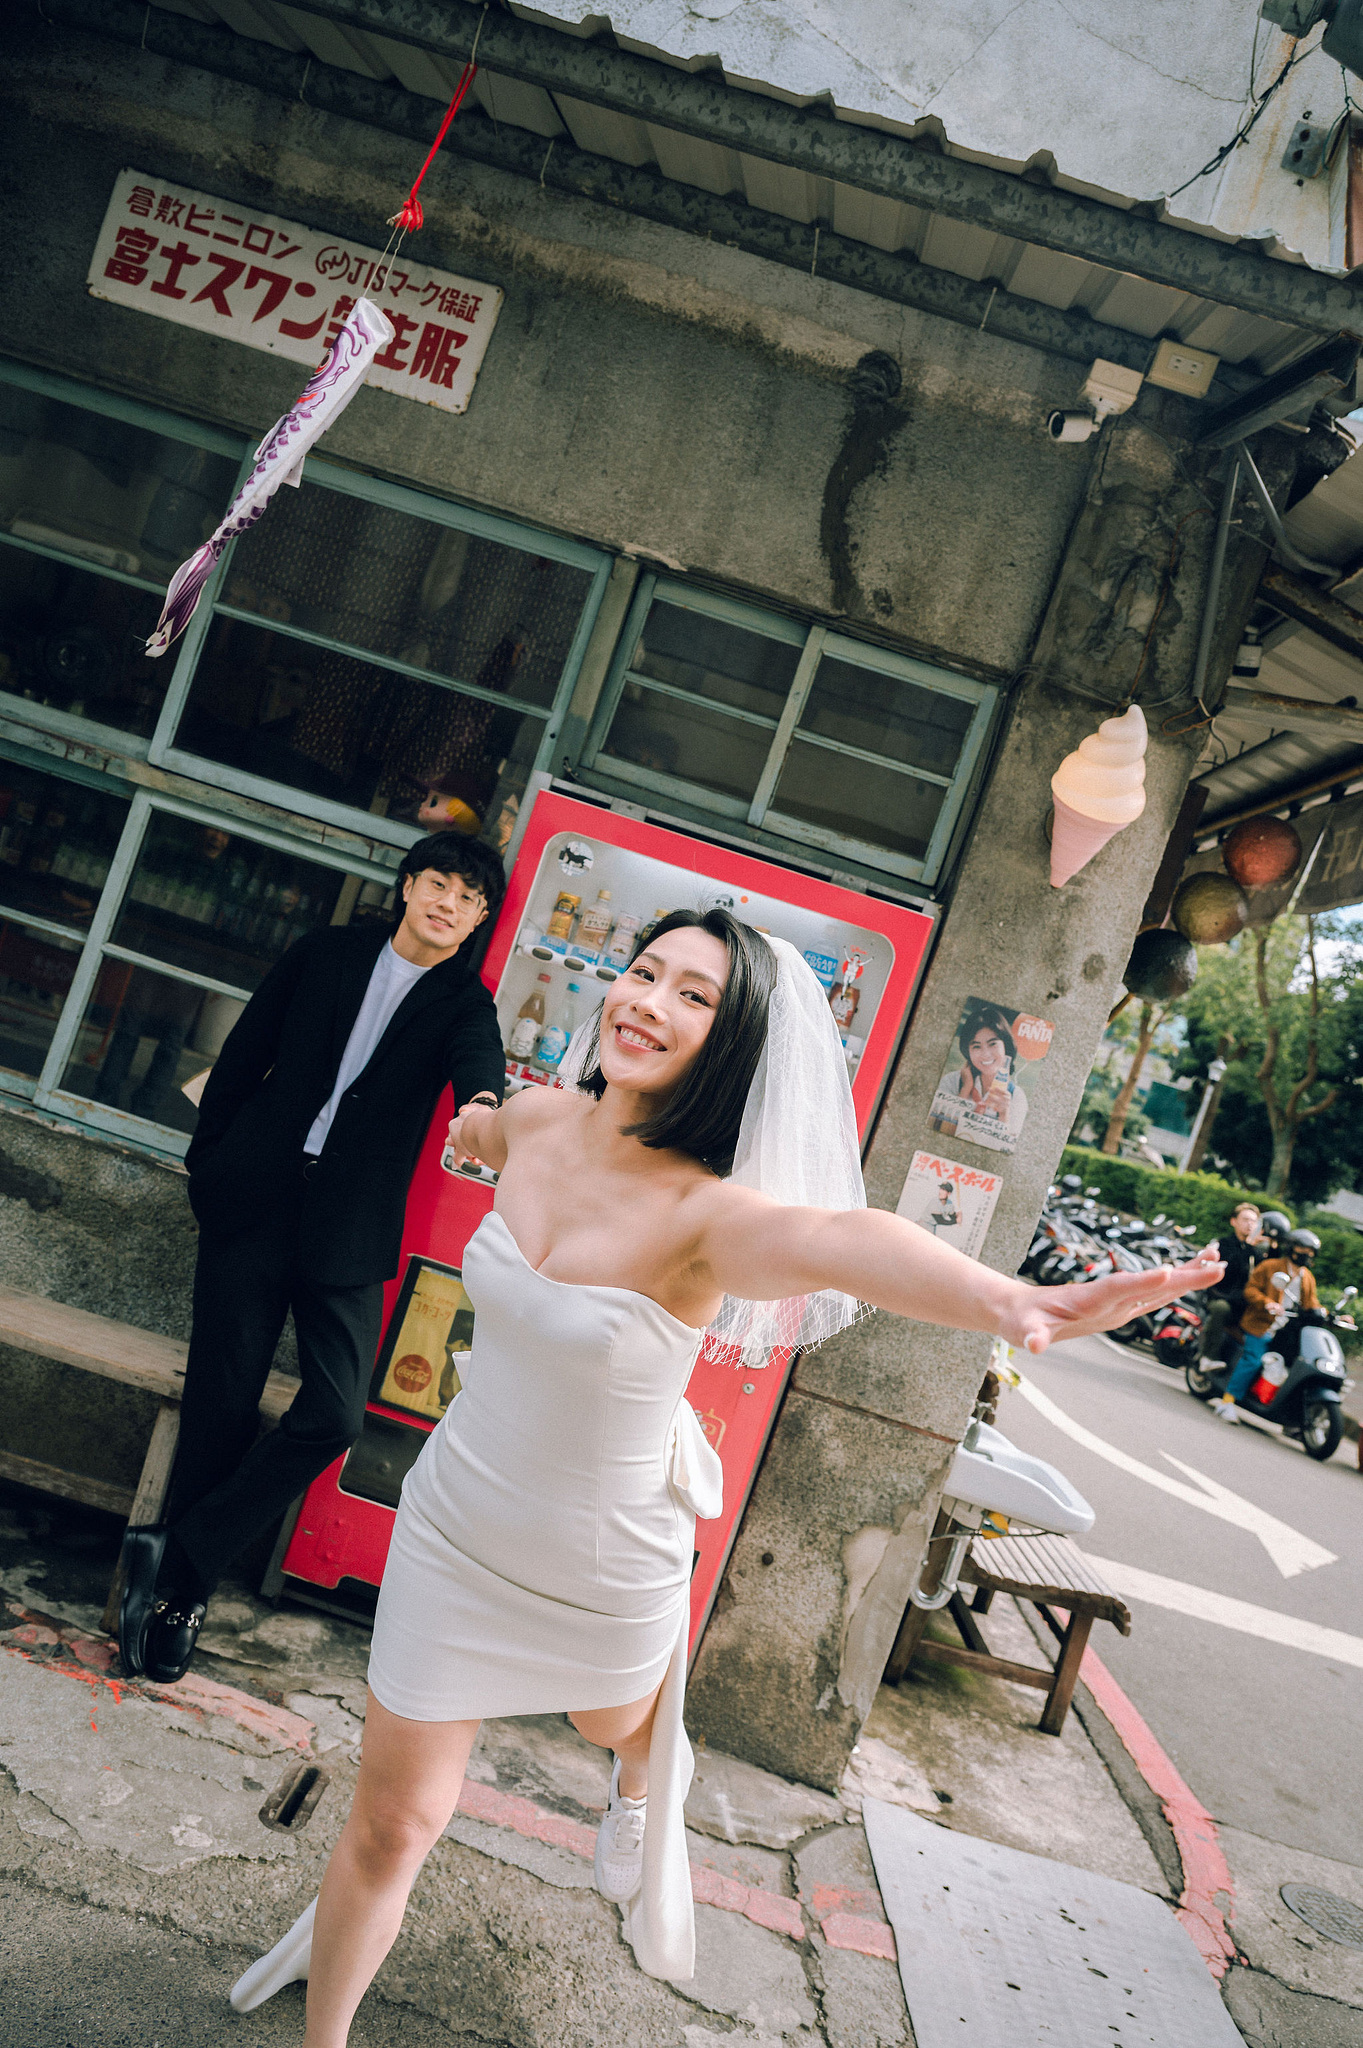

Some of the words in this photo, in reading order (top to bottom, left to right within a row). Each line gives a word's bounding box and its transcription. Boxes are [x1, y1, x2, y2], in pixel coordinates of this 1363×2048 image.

[125, 185, 303, 260] 倉敷ビニロン
[1018, 1021, 1053, 1043] FANTA
